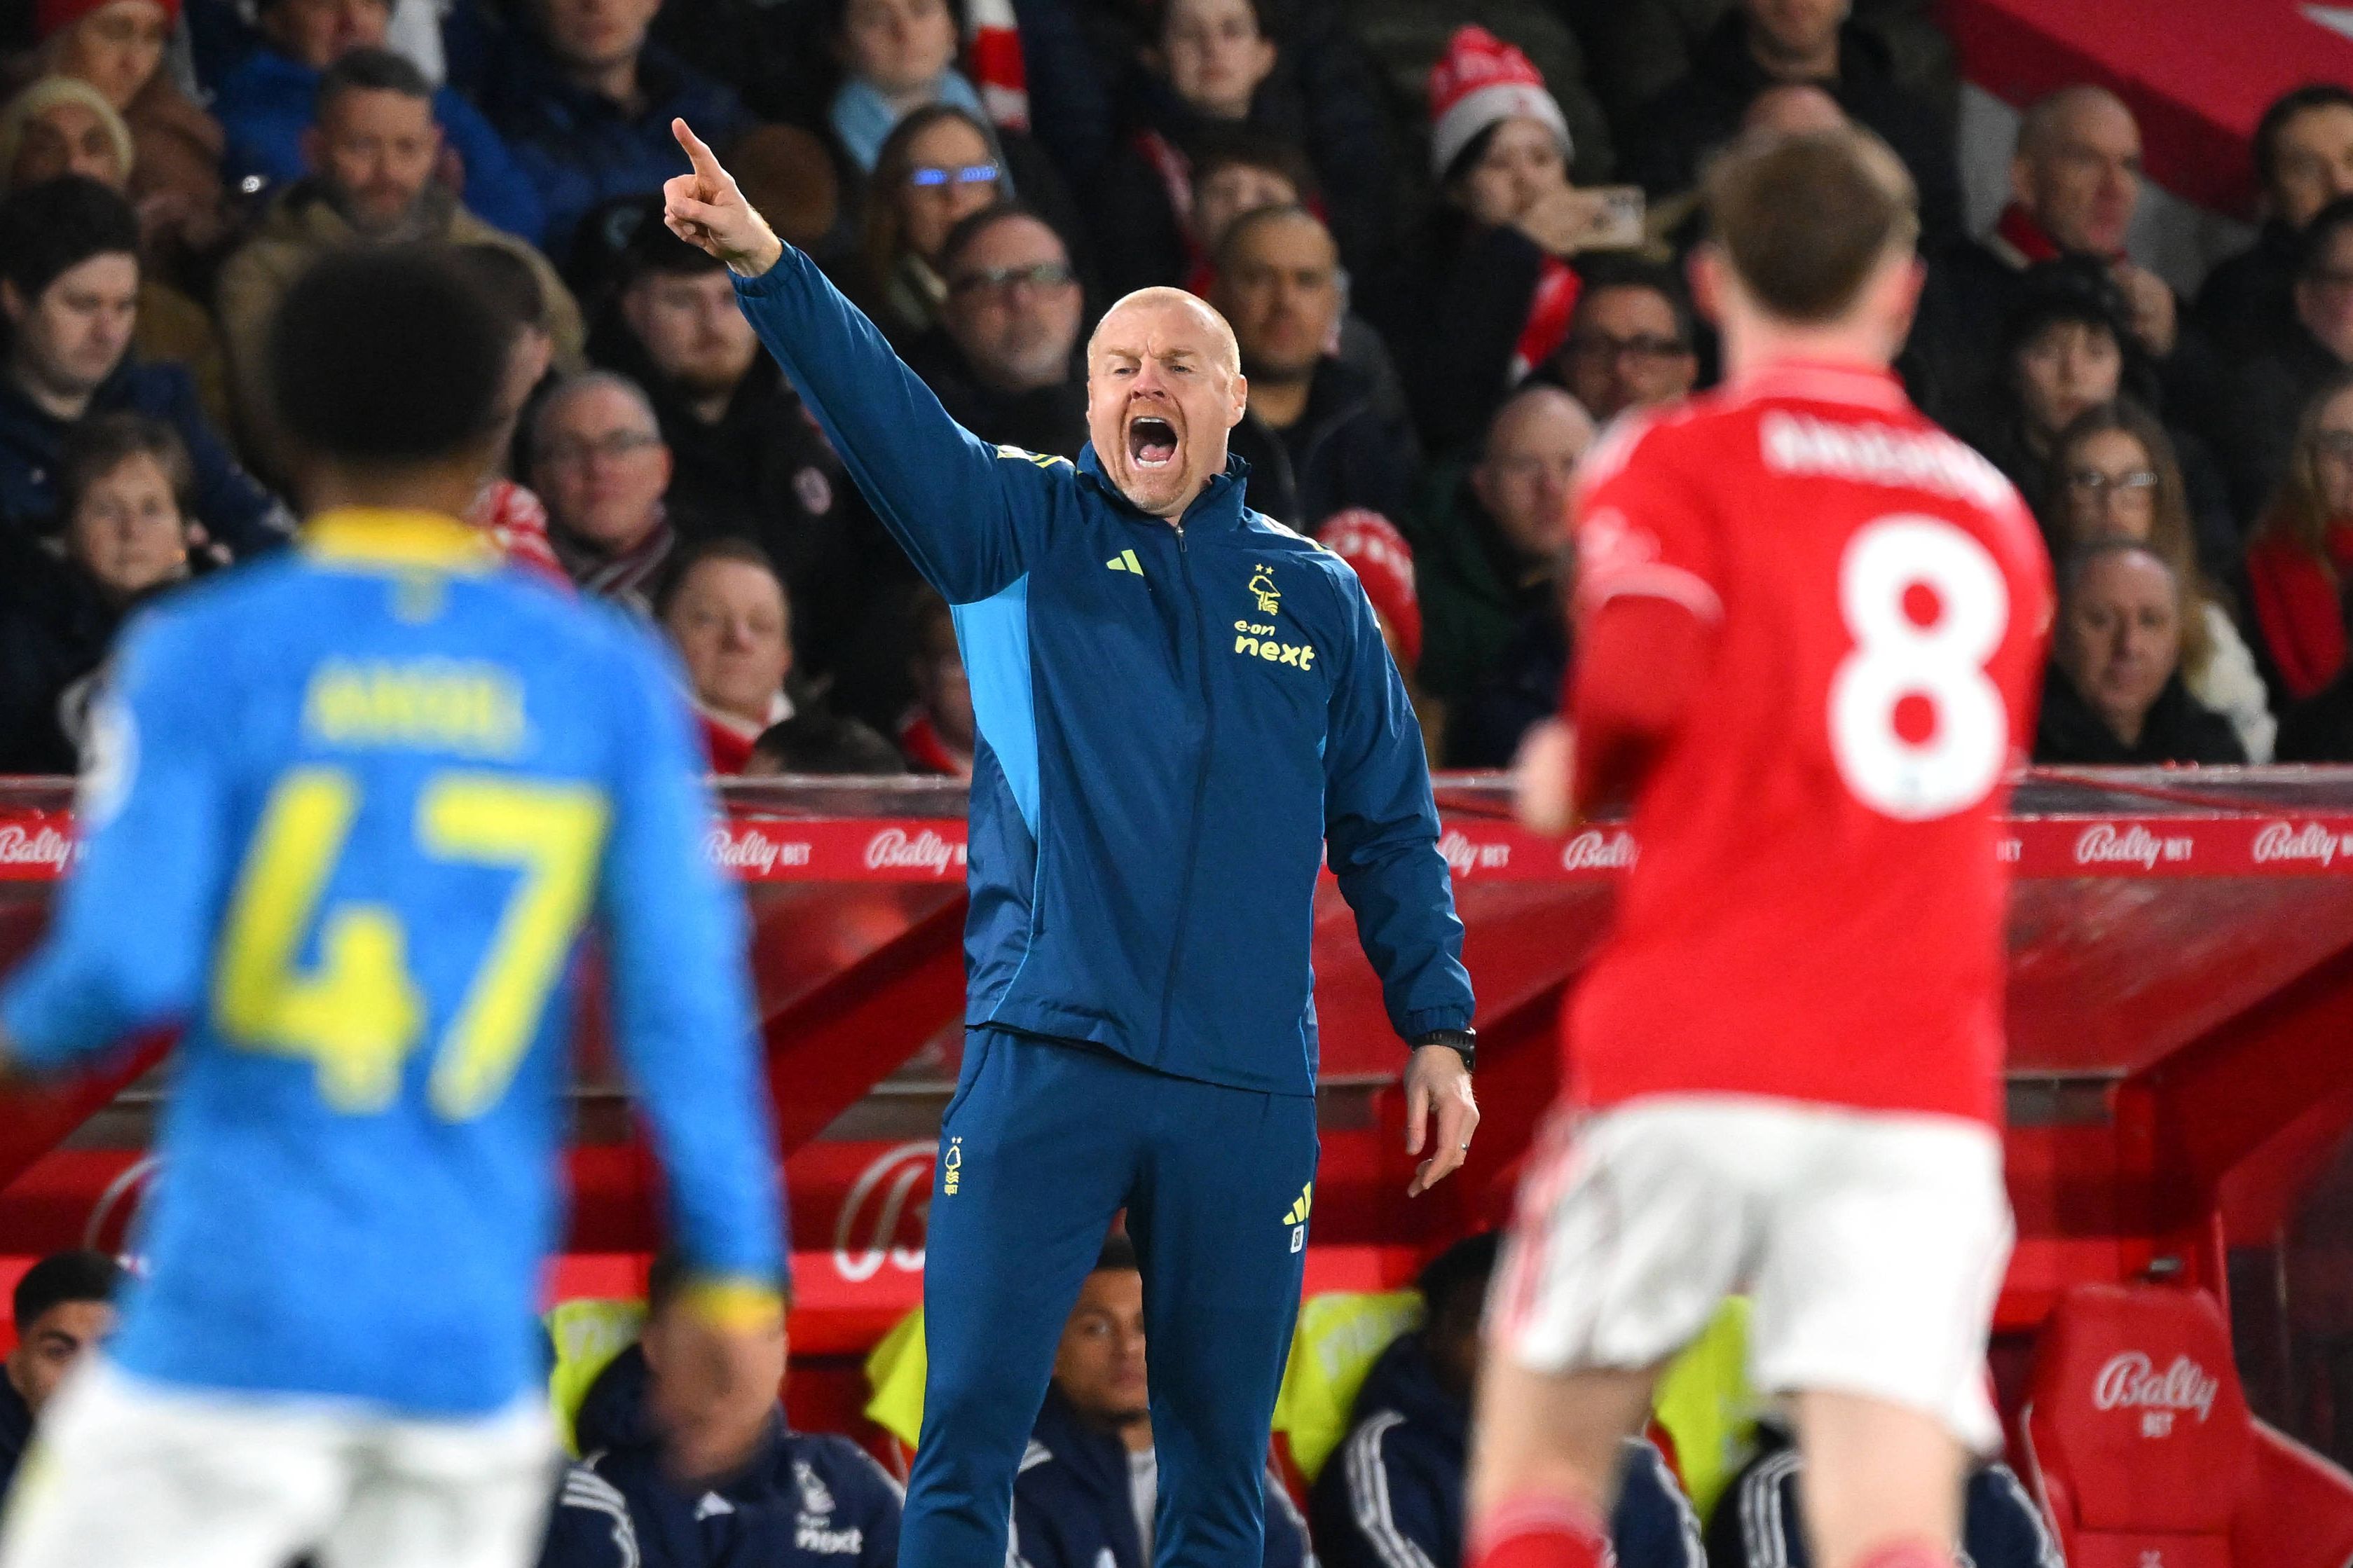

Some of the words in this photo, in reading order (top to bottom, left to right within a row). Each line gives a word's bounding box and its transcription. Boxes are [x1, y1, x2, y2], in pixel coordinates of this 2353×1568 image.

[1235, 635, 1315, 671] next
[1827, 510, 2011, 821] 8
[704, 829, 779, 875] Bally
[866, 829, 954, 875] Bally
[2076, 824, 2162, 870] Bally
[2253, 822, 2339, 867] Bally
[216, 764, 613, 1117] 47
[2094, 1351, 2220, 1422] Bally
